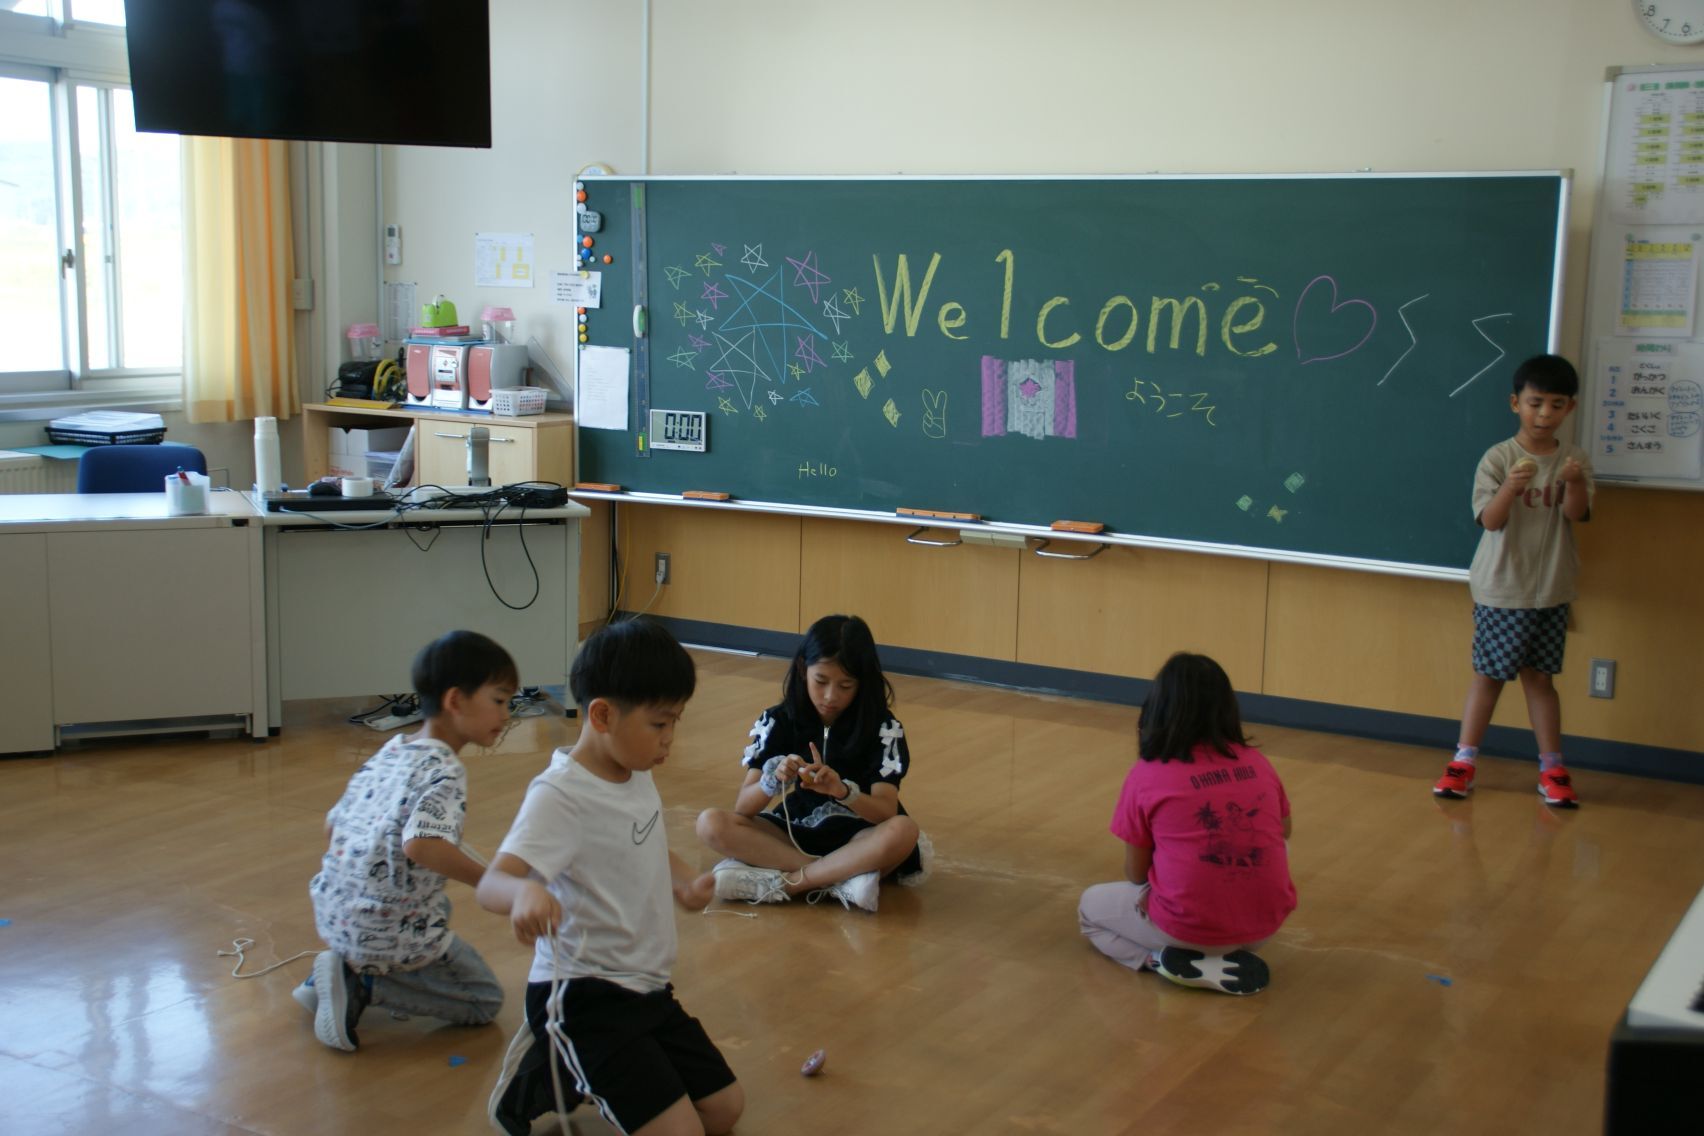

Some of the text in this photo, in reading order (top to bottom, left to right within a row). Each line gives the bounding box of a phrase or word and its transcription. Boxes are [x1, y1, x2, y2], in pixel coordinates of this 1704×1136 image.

[1647, 5, 1655, 17] 8
[1663, 18, 1671, 30] 7
[1681, 22, 1690, 34] 6
[873, 249, 1279, 358] Welcome
[1609, 388, 1616, 398] 2
[1125, 377, 1216, 426] ようこそ
[1608, 410, 1615, 421] 3
[664, 413, 702, 442] 0:00
[1607, 422, 1614, 432] 4
[1605, 444, 1614, 454] 5
[798, 461, 837, 480] Hello
